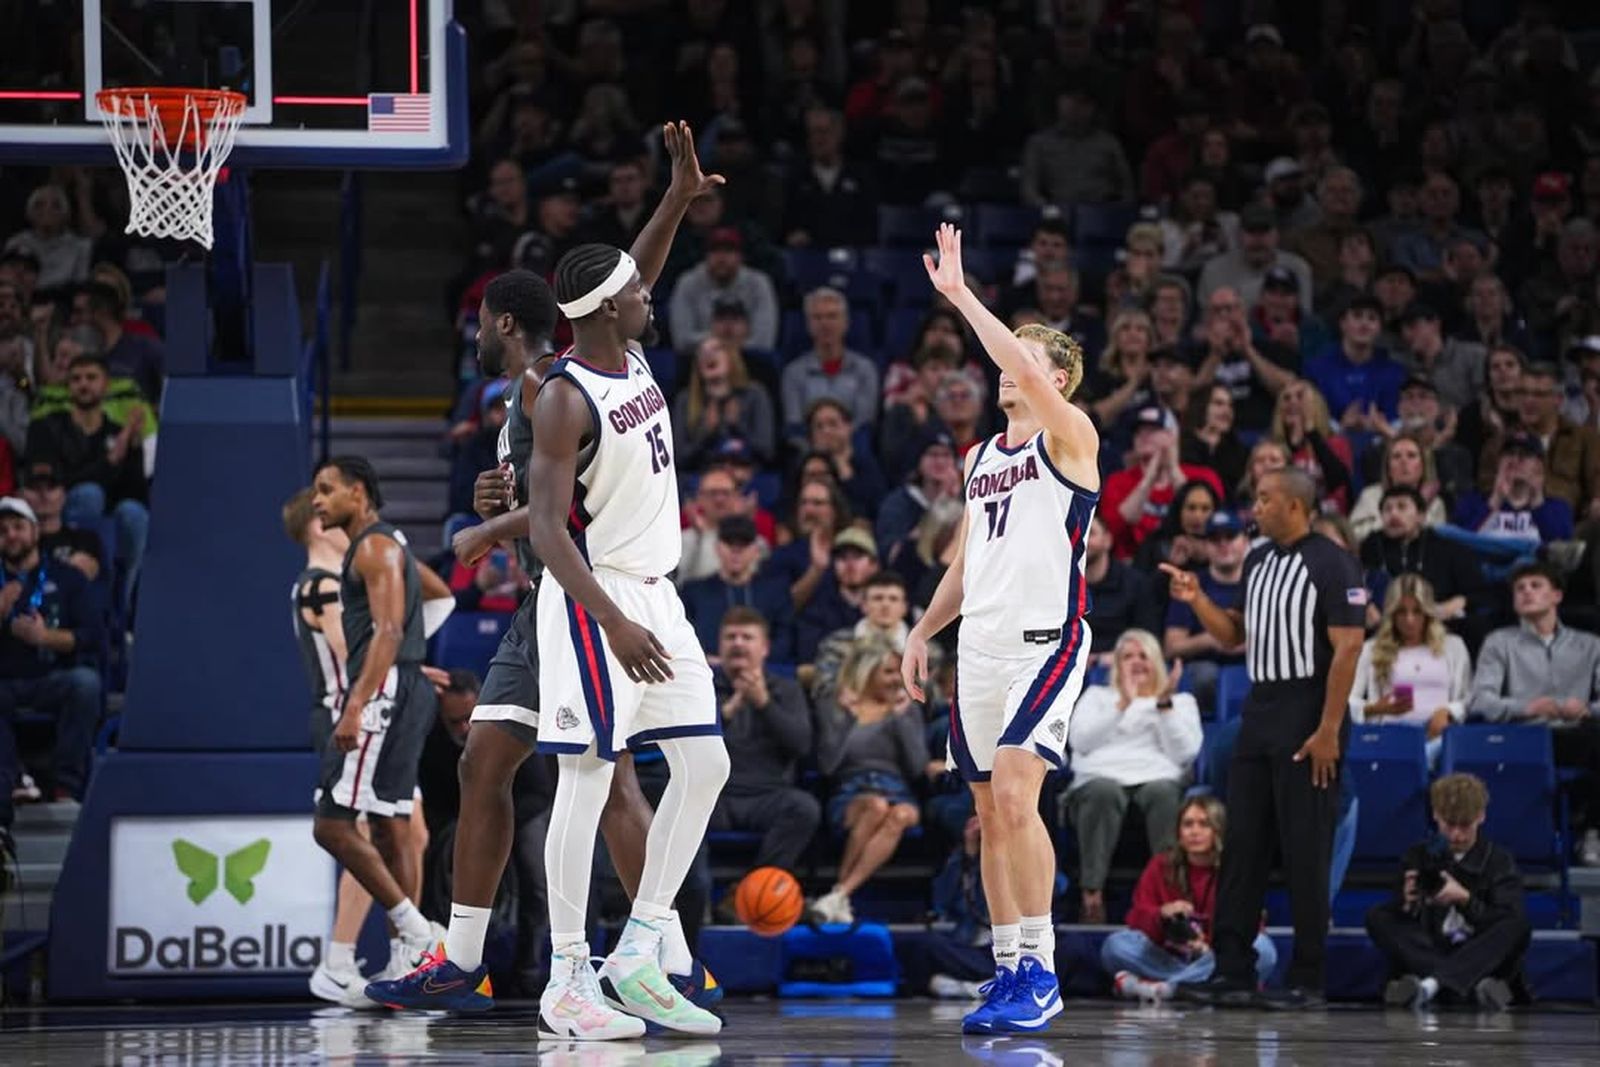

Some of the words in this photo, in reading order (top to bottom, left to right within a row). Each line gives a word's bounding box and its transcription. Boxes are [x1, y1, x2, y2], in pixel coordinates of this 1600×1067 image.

[608, 385, 665, 435] GONZAGA
[645, 422, 670, 474] 15
[115, 924, 322, 970] DaBella
